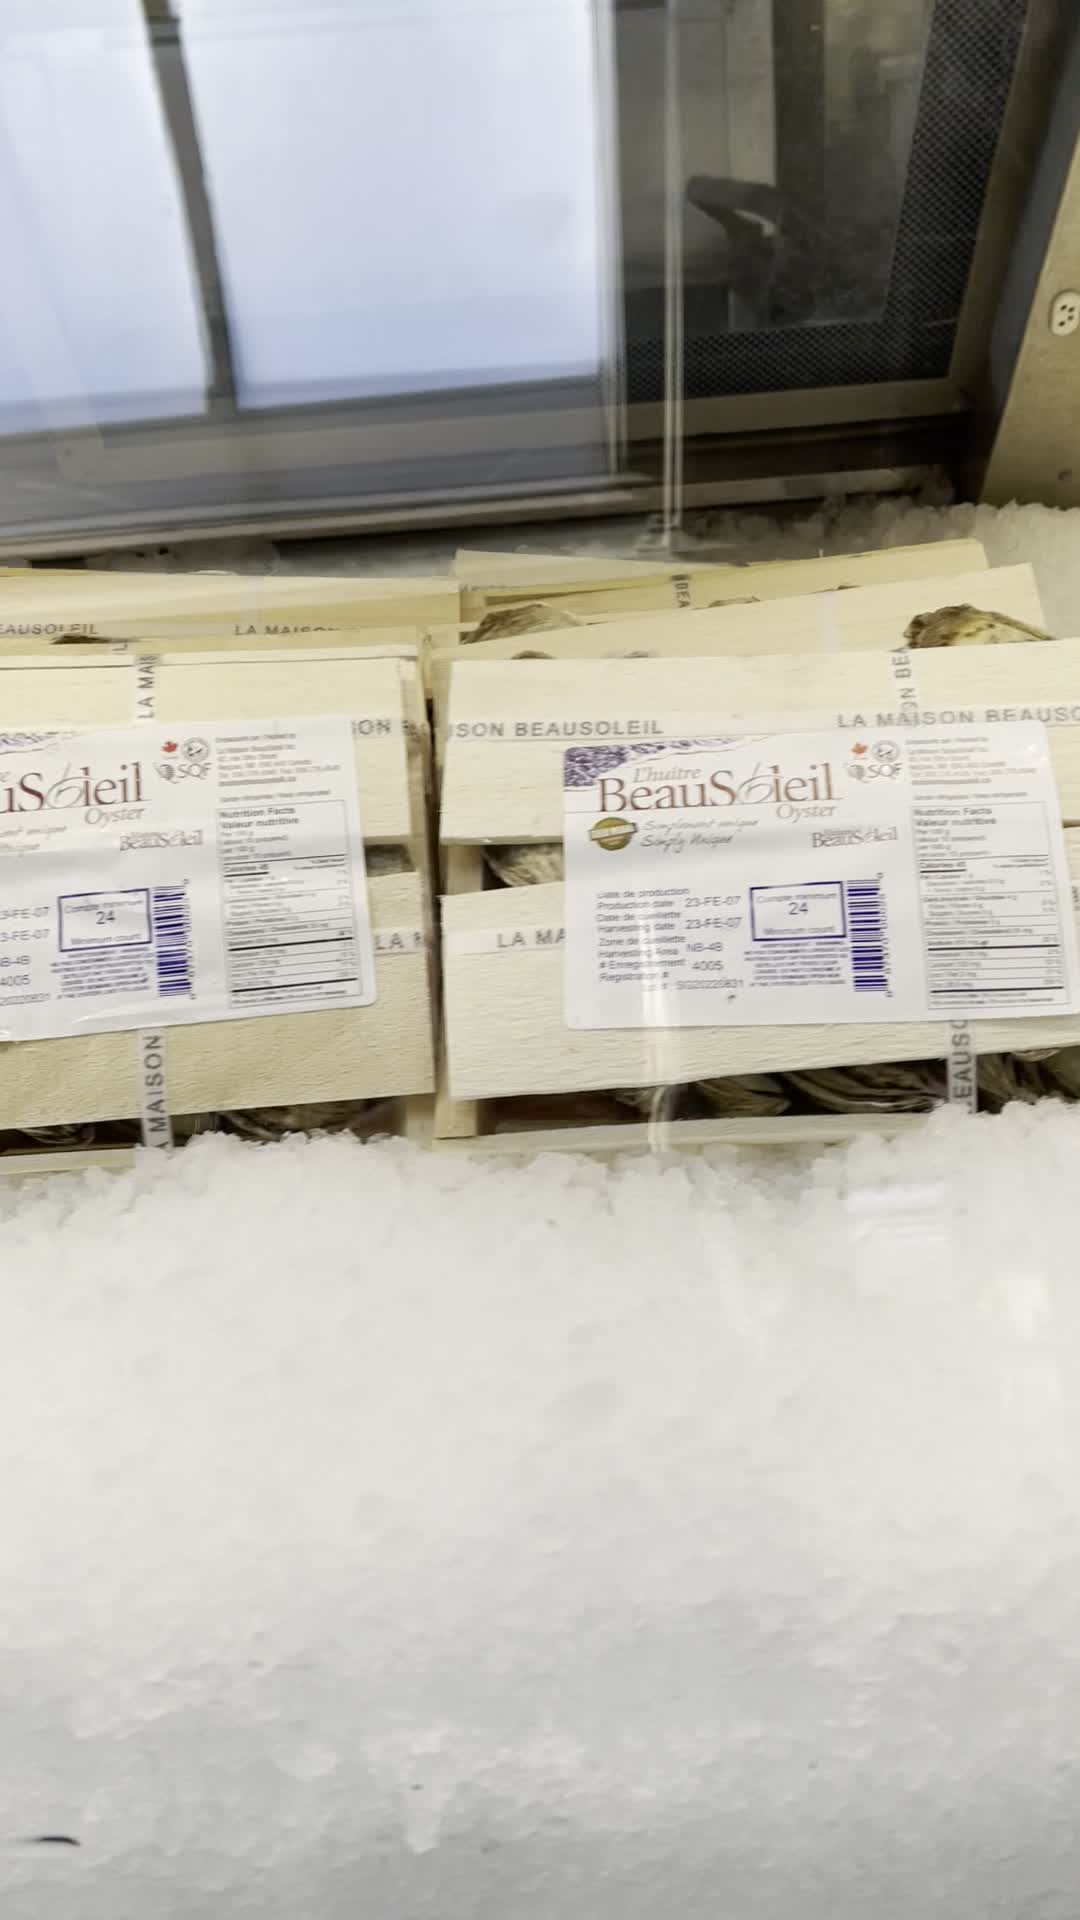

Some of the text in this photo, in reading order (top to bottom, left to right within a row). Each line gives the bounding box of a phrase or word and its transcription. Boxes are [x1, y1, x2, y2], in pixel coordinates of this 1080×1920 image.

[514, 719, 665, 737] BEAUSOLEIL
[837, 713, 867, 729] LA
[876, 709, 974, 727] MAISON
[597, 760, 834, 812] BeauSoleil
[84, 808, 145, 828] Oyster
[775, 804, 838, 823] Oyster
[684, 895, 742, 908] 23-FE-07
[788, 902, 809, 916] 24
[95, 910, 116, 926] 24
[684, 916, 743, 930] 23-FE-07
[374, 927, 406, 950] LA
[496, 931, 528, 948] LA
[143, 1035, 168, 1133] MAISON
